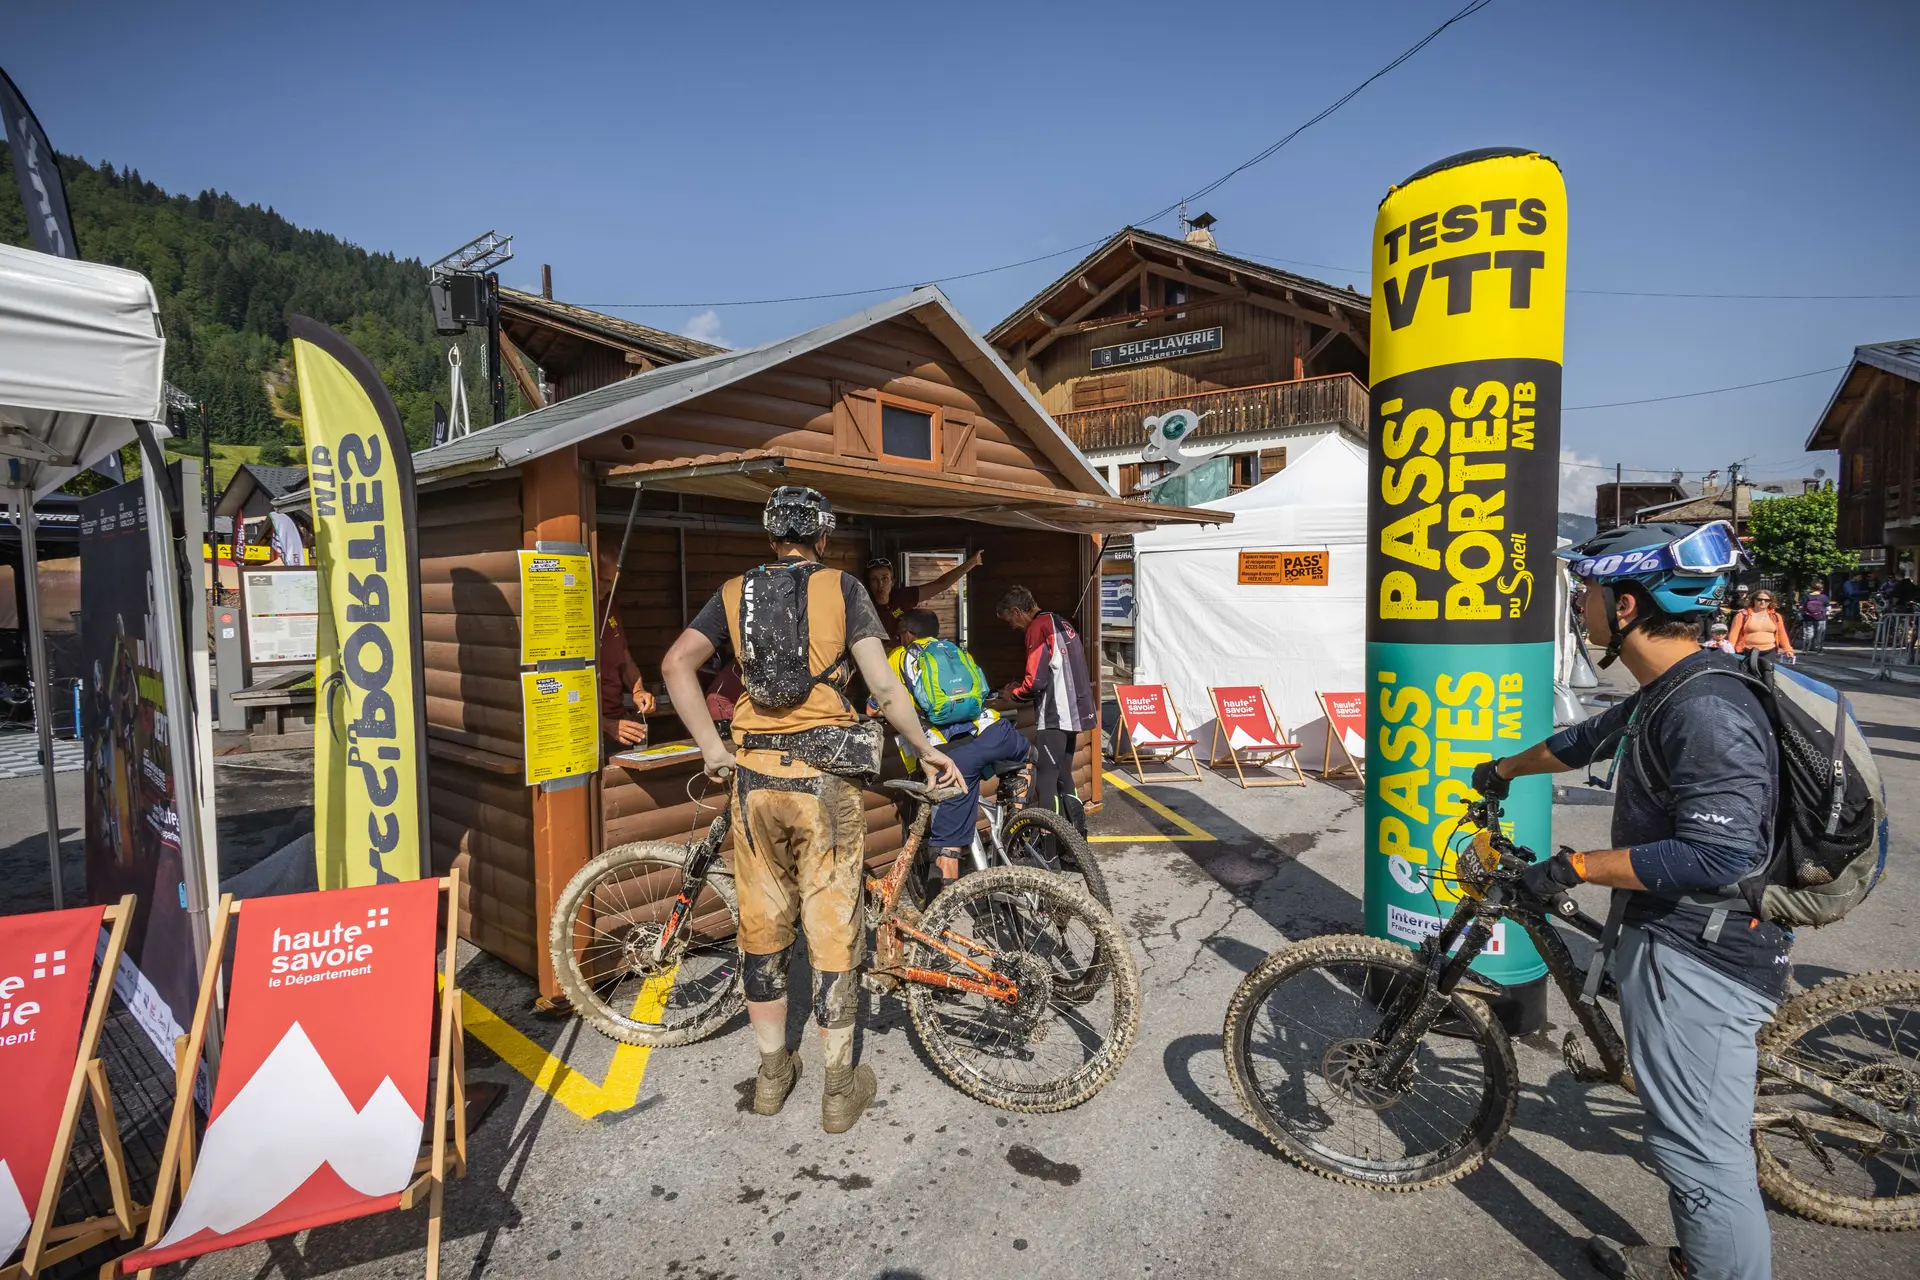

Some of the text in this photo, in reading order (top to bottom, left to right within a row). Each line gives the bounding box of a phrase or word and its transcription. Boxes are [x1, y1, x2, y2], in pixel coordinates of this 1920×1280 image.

[1383, 198, 1547, 266] TESTS
[1383, 250, 1545, 332] VTT
[1118, 330, 1215, 357] SELF-LAVERIE
[1511, 381, 1537, 451] MTB
[1380, 398, 1445, 620] PASS'
[1445, 380, 1510, 620] PORTES
[1283, 553, 1322, 569] PASS'
[1284, 566, 1323, 578] PORTES
[1496, 532, 1534, 619] DU Soleil
[1126, 696, 1151, 705] haute
[1223, 699, 1249, 708] haute
[1225, 706, 1254, 714] savoie
[1498, 672, 1523, 739] MTB
[1391, 908, 1446, 932] Interre
[1391, 921, 1416, 936] France
[272, 921, 363, 953] haute
[271, 944, 373, 974] savoie
[268, 964, 372, 988] le Département
